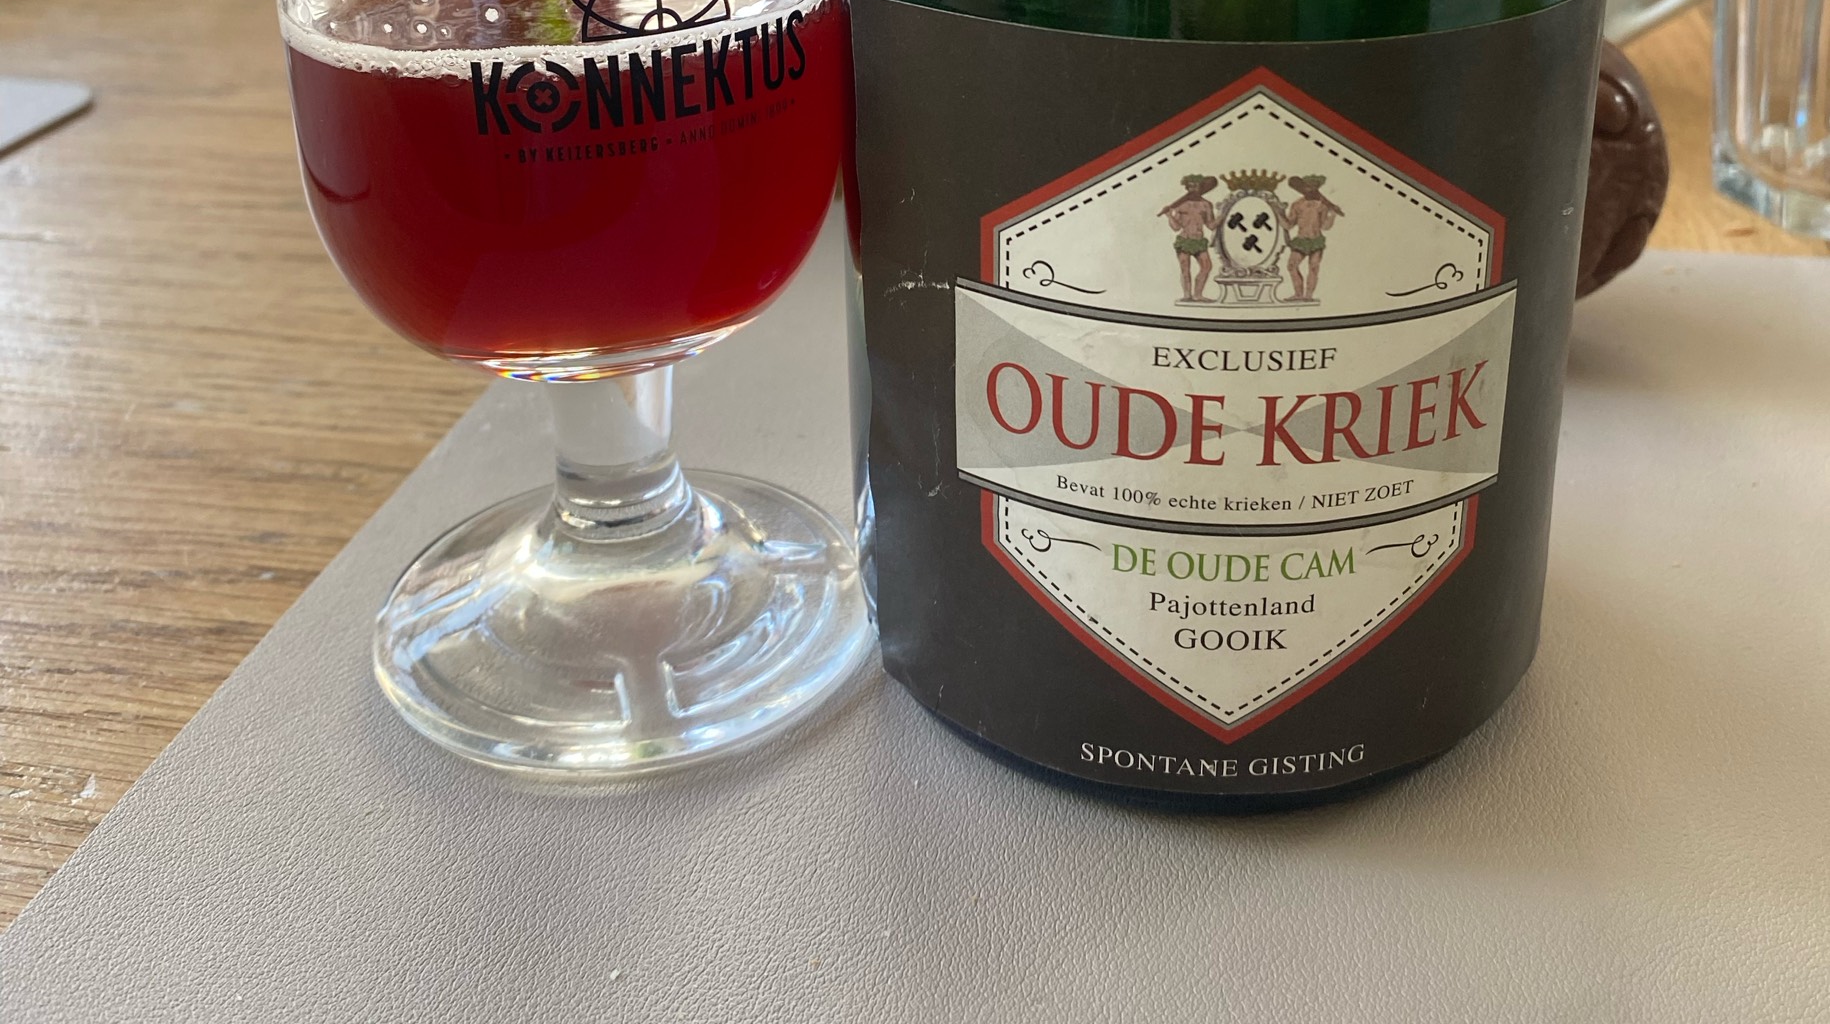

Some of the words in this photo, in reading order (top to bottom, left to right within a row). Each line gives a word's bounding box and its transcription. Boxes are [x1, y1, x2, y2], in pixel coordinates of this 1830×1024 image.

[470, 10, 806, 136] KONNEKTUS
[518, 148, 537, 163] BY
[546, 136, 659, 162] KEIZERSBERG
[1152, 347, 1338, 372] EXCLUSIEF
[986, 361, 1226, 467] OUDE
[1256, 360, 1489, 467] KRIEK
[1056, 475, 1105, 498] Bevat
[1112, 486, 1161, 506] 100%
[1168, 495, 1217, 511] echte
[1224, 496, 1292, 511] krieken
[1311, 490, 1360, 509] NIET
[1365, 479, 1414, 501] ZOET
[1111, 543, 1157, 576] DE
[1167, 551, 1270, 583] OUDE
[1280, 546, 1357, 581] CAM
[1149, 591, 1316, 619] Pajottenland
[1174, 628, 1288, 651] GOOIK
[1080, 742, 1238, 777] SPONTANE
[1248, 743, 1365, 776] GISTING
